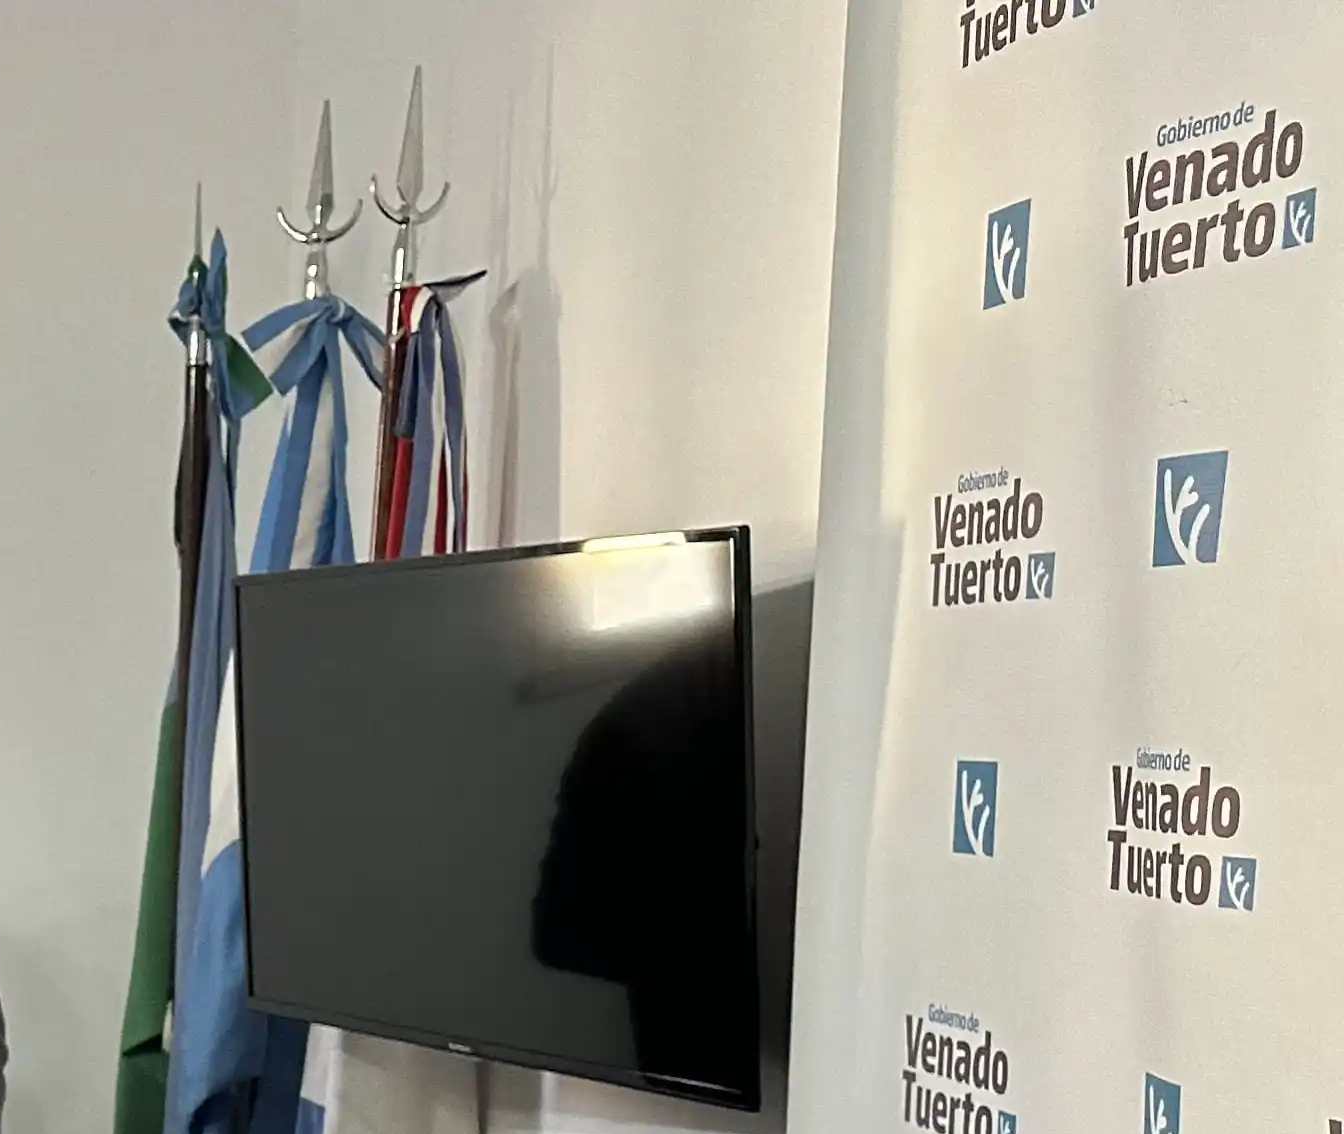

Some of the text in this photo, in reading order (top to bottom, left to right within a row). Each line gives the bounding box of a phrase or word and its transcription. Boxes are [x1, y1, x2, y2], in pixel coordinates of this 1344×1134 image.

[960, 0, 1066, 68] Tuerto
[1157, 100, 1255, 147] Gobierno de
[1126, 109, 1303, 219] Venado
[1124, 199, 1275, 287] Tuerto
[935, 478, 1043, 549] Venado
[931, 549, 1021, 606] Tuerto
[1113, 765, 1240, 838] Venado
[1108, 830, 1211, 905] Tuerto
[906, 1015, 1008, 1095] Venado
